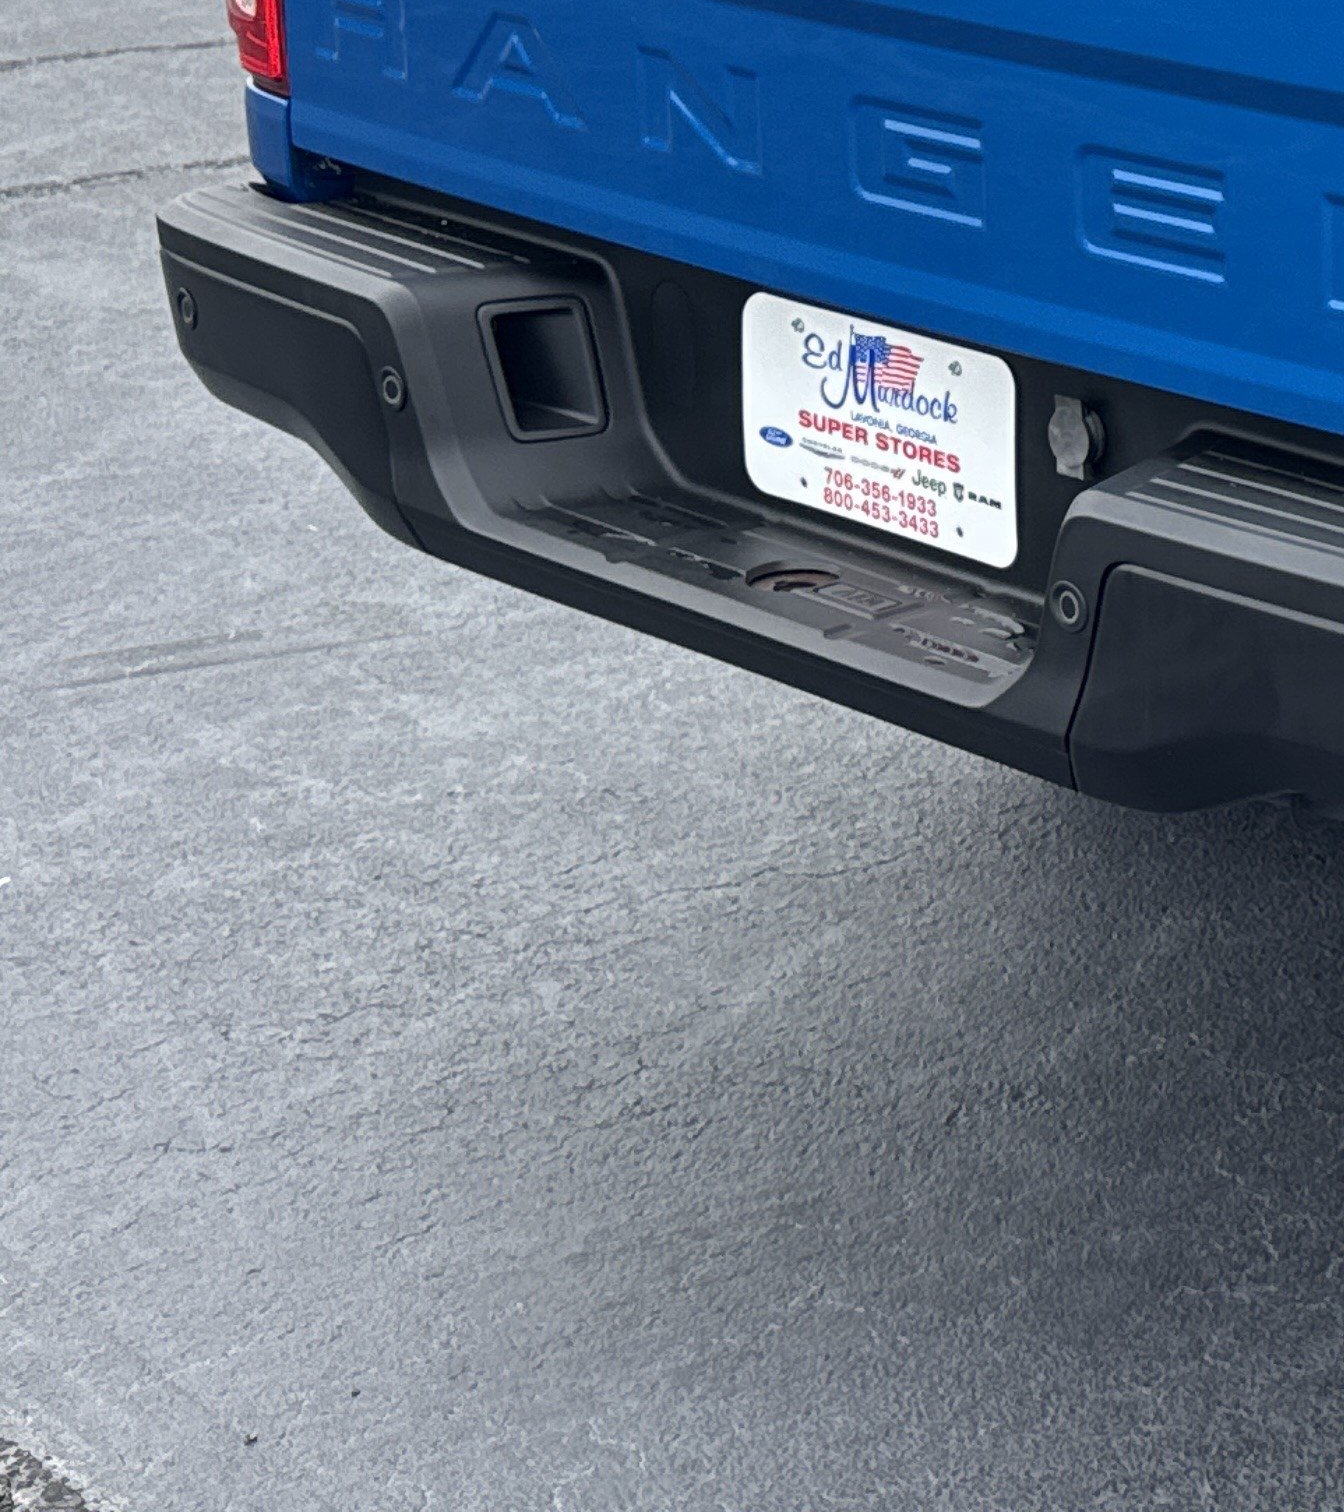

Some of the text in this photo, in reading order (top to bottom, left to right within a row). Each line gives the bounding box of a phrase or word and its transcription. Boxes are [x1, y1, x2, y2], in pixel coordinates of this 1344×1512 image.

[802, 332, 959, 424] Ed Murdock
[798, 409, 961, 474] SUPER STORES
[823, 466, 937, 518] 706-356-1933
[911, 469, 948, 498] Jeep
[967, 490, 1002, 510] RAM
[823, 486, 940, 539] 800-453-3433
